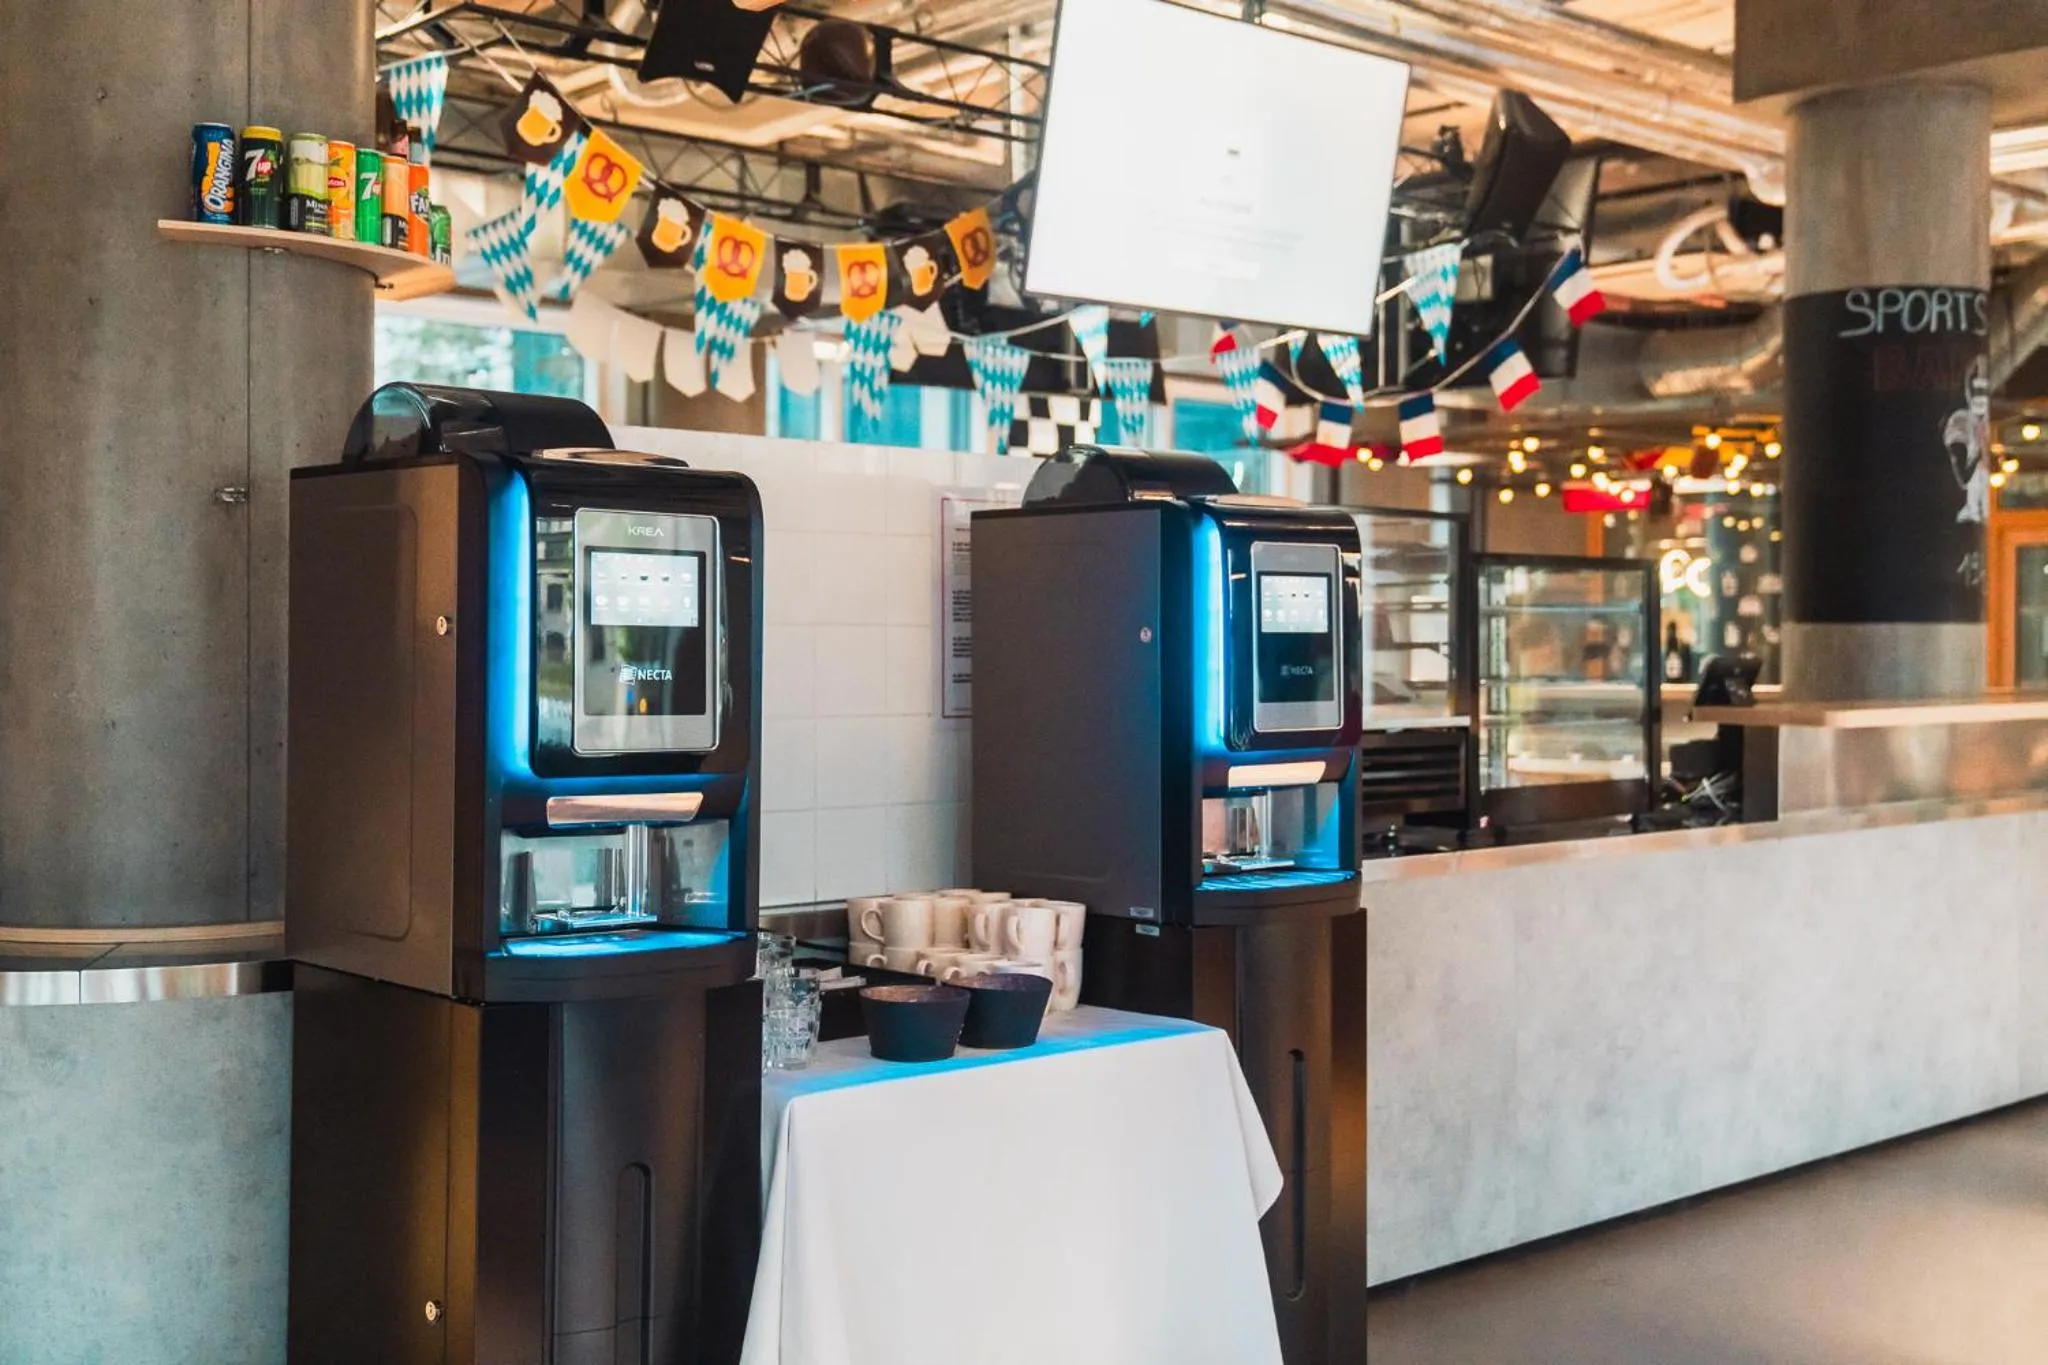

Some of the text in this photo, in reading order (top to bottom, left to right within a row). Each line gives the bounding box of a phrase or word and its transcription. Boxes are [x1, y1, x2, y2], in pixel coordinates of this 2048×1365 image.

[203, 138, 234, 212] ORANGINA
[1837, 286, 1989, 339] SPORTS
[628, 526, 665, 536] KREA
[638, 668, 673, 681] NECTA
